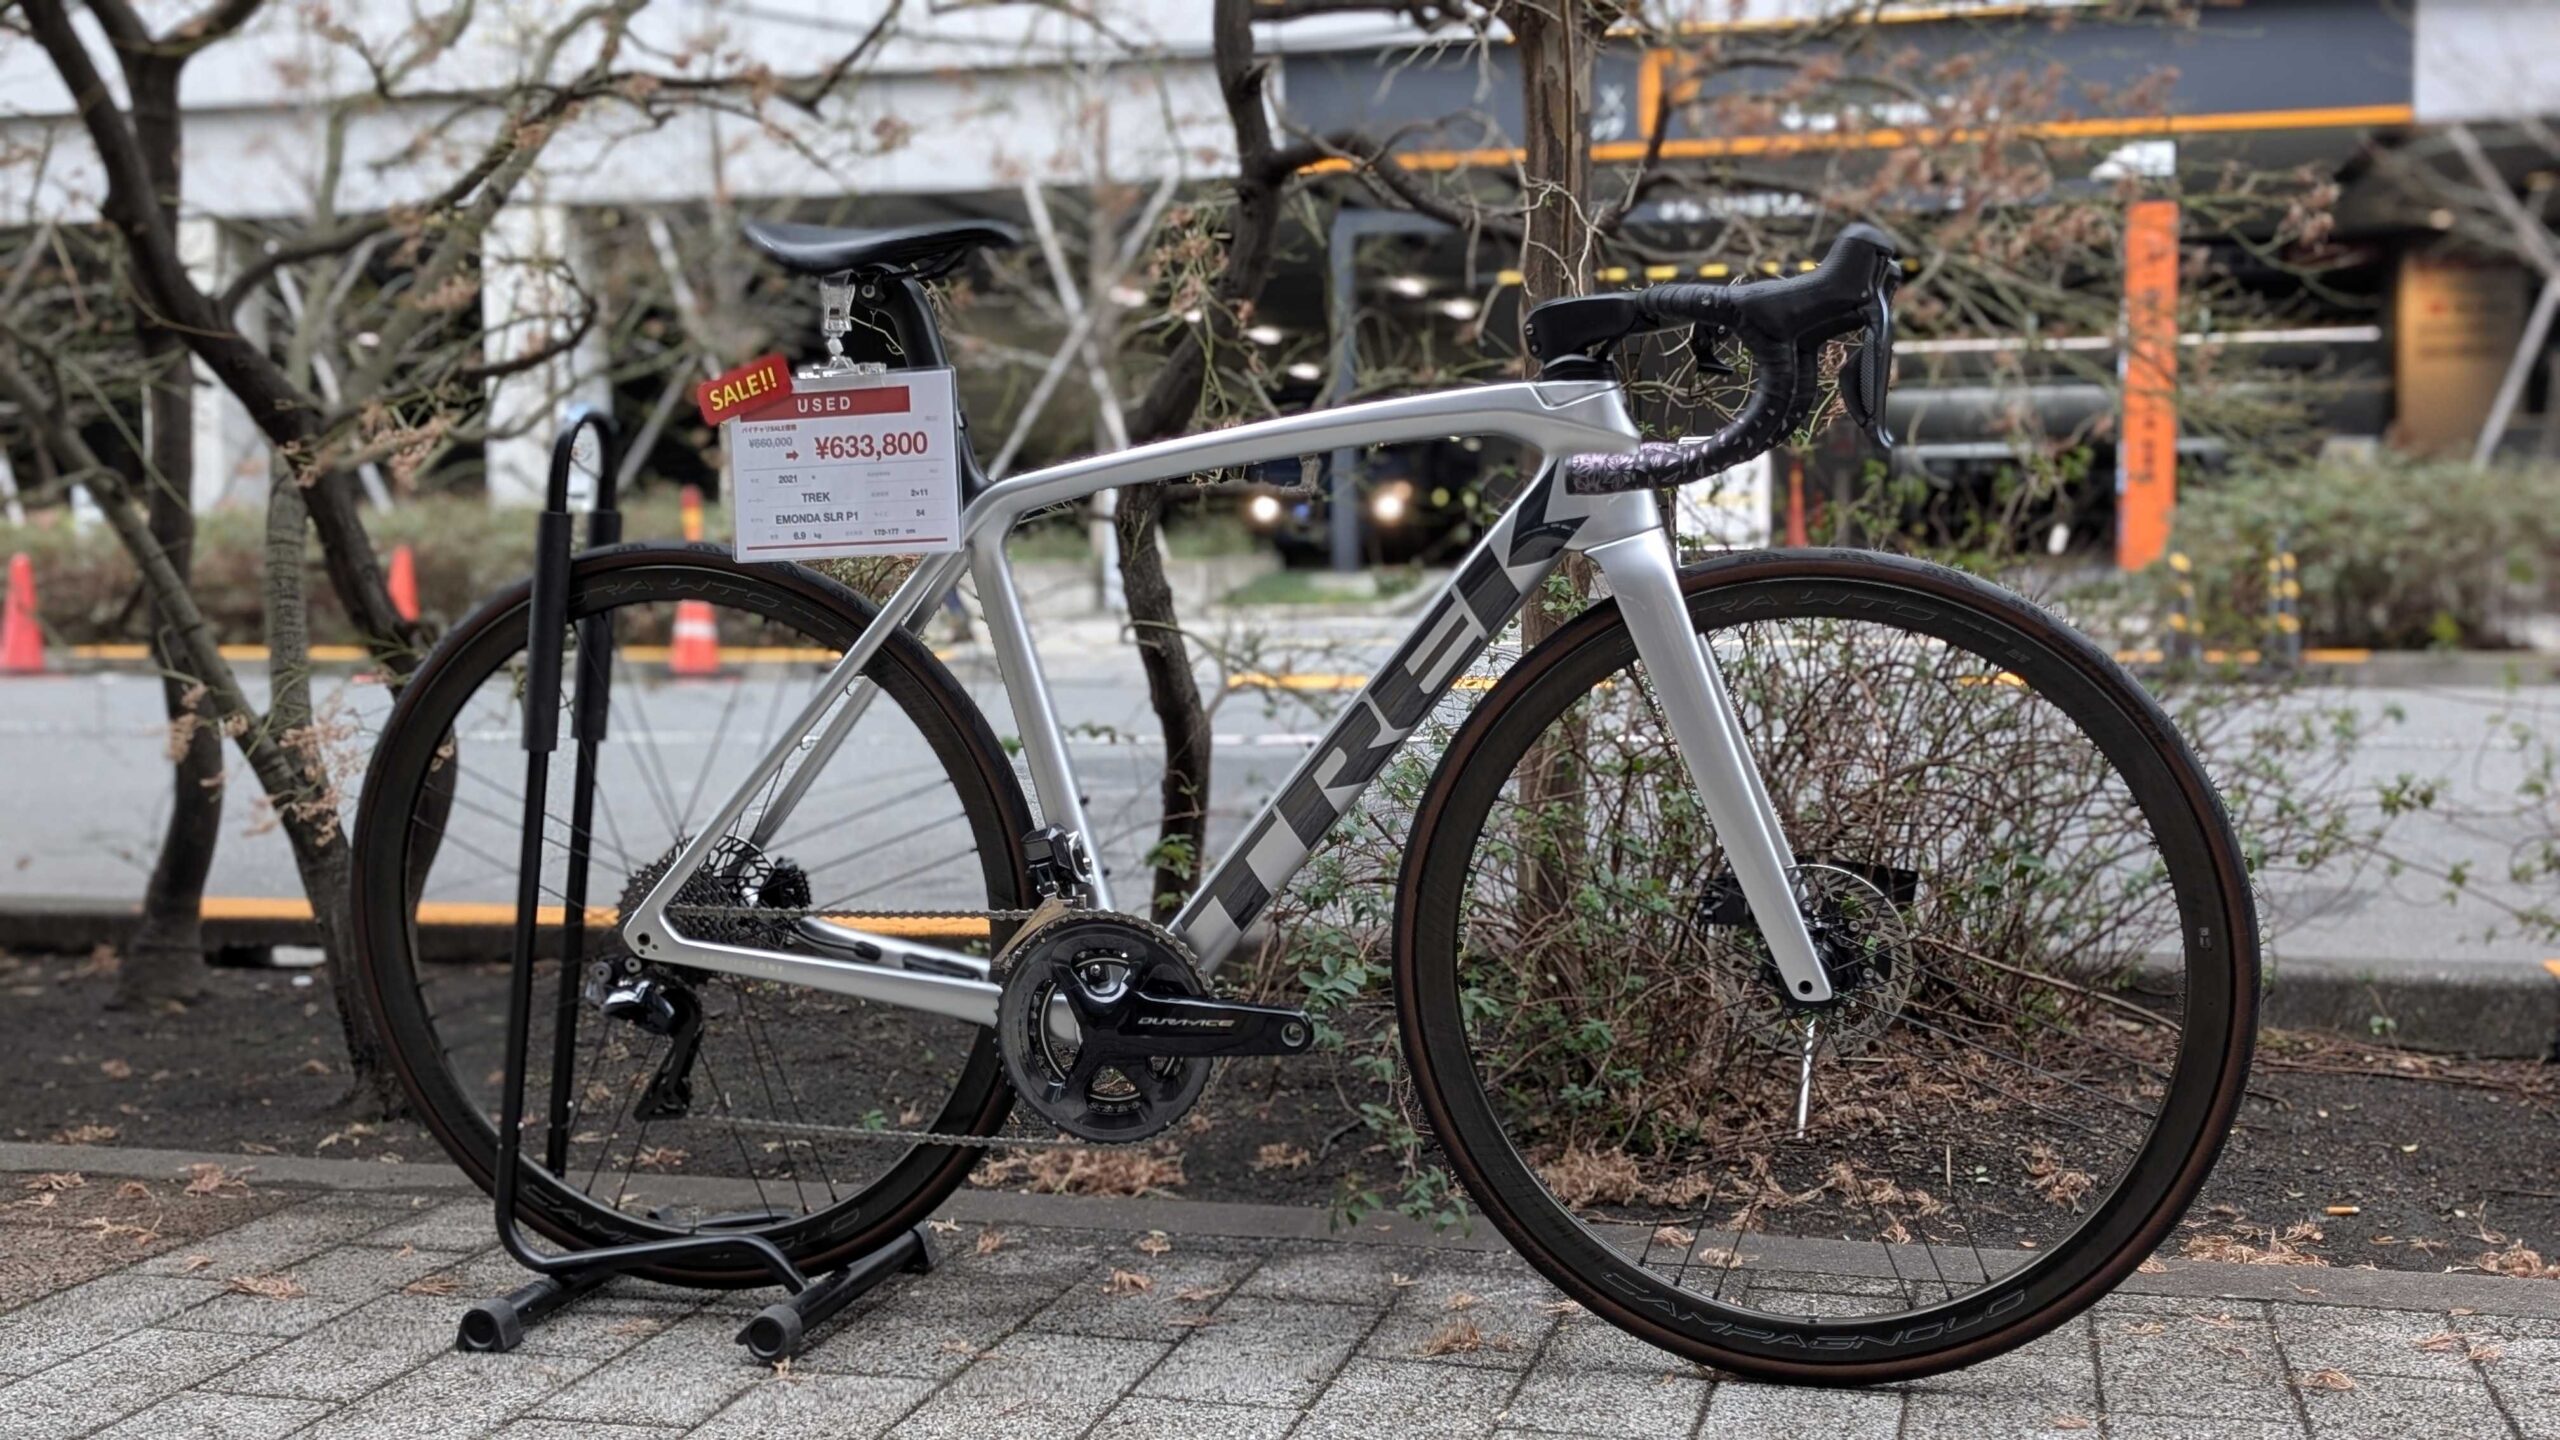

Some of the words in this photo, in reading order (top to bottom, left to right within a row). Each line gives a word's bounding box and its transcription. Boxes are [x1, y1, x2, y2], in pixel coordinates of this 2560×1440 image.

[708, 366, 778, 412] SALE!!
[797, 396, 851, 413] USED
[814, 431, 928, 461] ¥633,800
[778, 474, 798, 485] 2021
[801, 492, 831, 503] TREK
[775, 513, 821, 525] EMONDA
[823, 512, 844, 522] SLR
[846, 511, 859, 521] P1
[1180, 457, 1590, 932] TREK
[1601, 1271, 2028, 1351] CAMPAGNOLO
